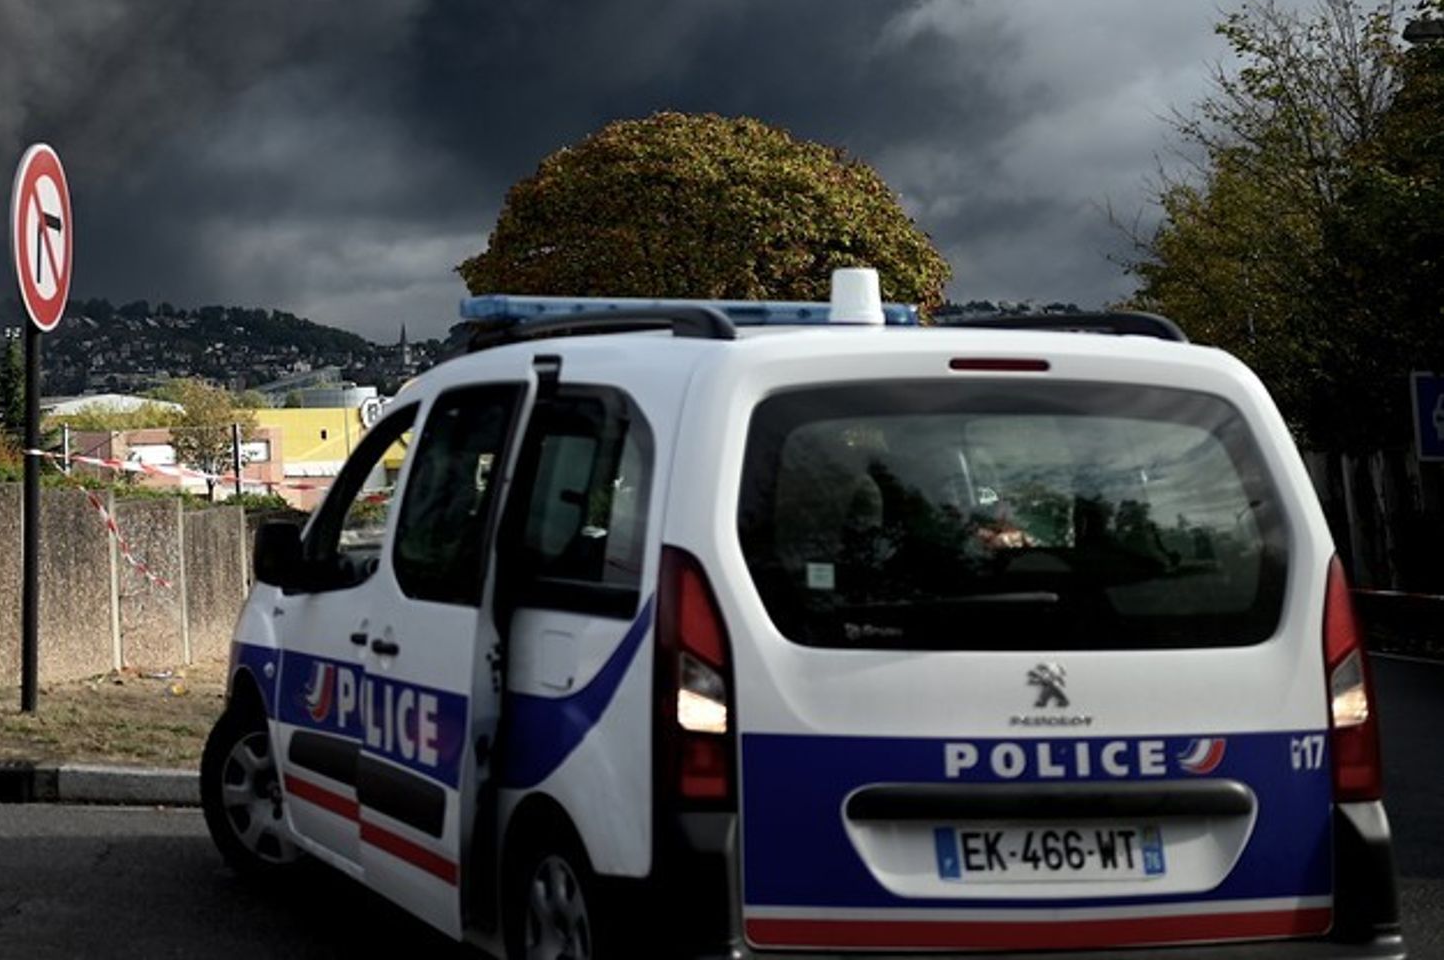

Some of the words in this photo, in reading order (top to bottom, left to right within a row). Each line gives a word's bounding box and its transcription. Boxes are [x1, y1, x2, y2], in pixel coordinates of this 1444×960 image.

[944, 741, 1167, 778] POLICE
[1302, 735, 1325, 769] 17
[961, 829, 1136, 872] EK-466-WT
